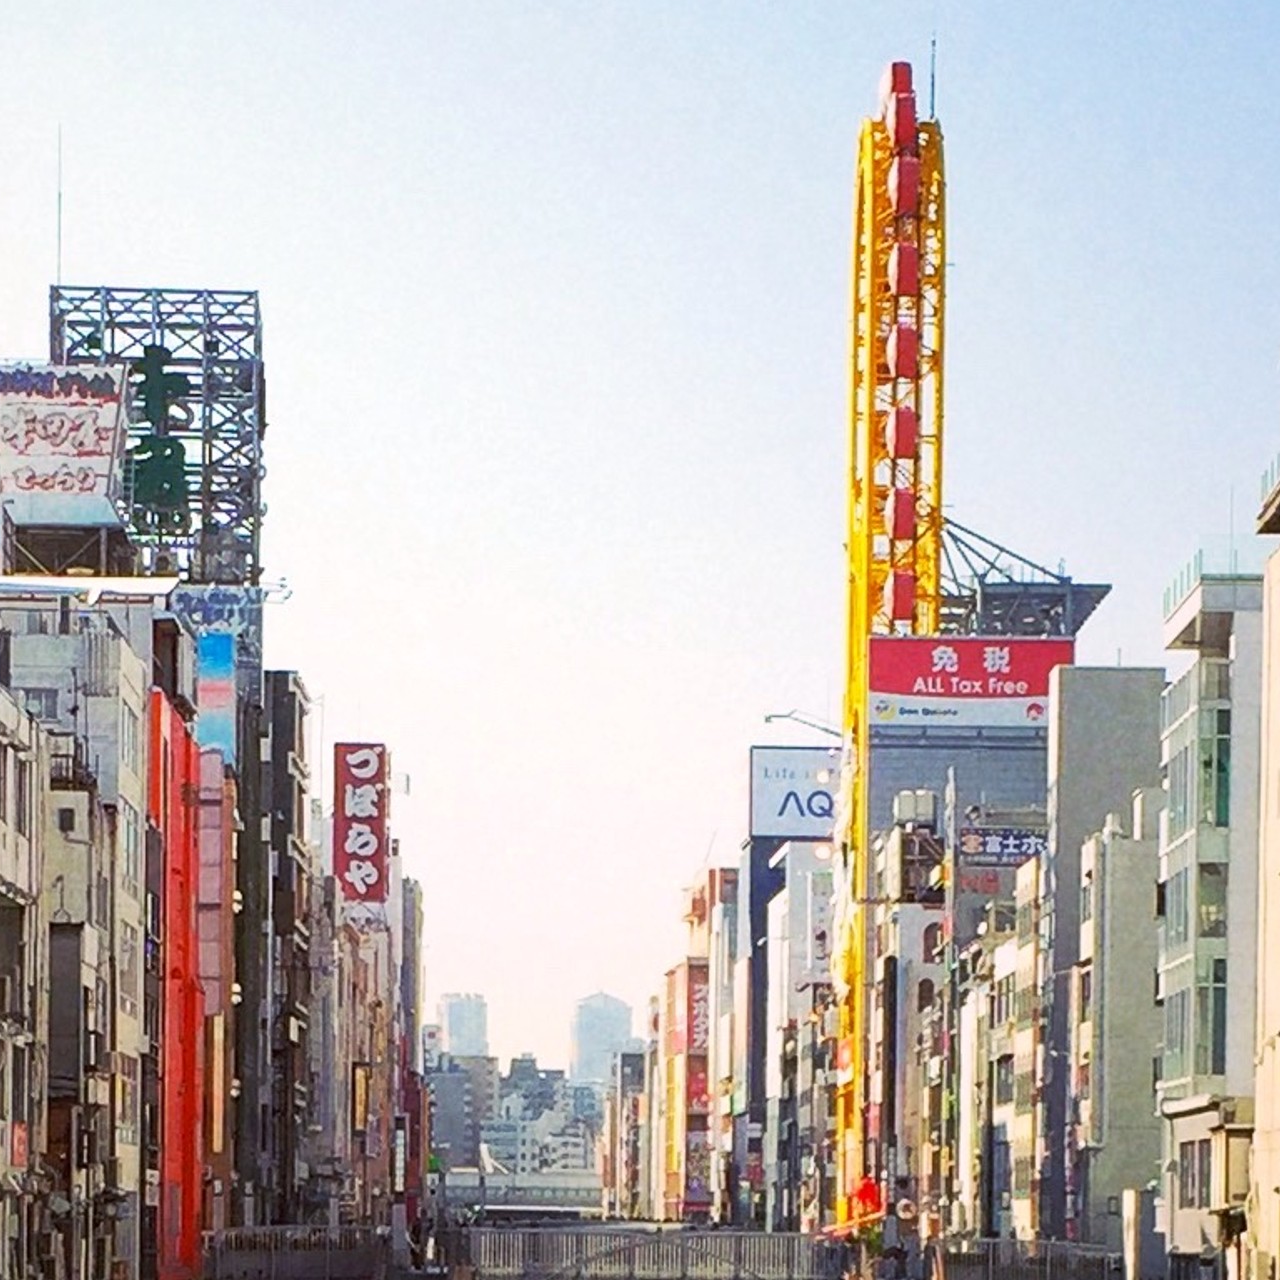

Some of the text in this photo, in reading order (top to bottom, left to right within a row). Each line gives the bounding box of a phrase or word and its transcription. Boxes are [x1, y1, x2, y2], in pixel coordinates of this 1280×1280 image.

[931, 645, 1011, 673] 免税
[913, 677, 1028, 695] ALL Tax Free
[985, 835, 1048, 854] 富士ホ
